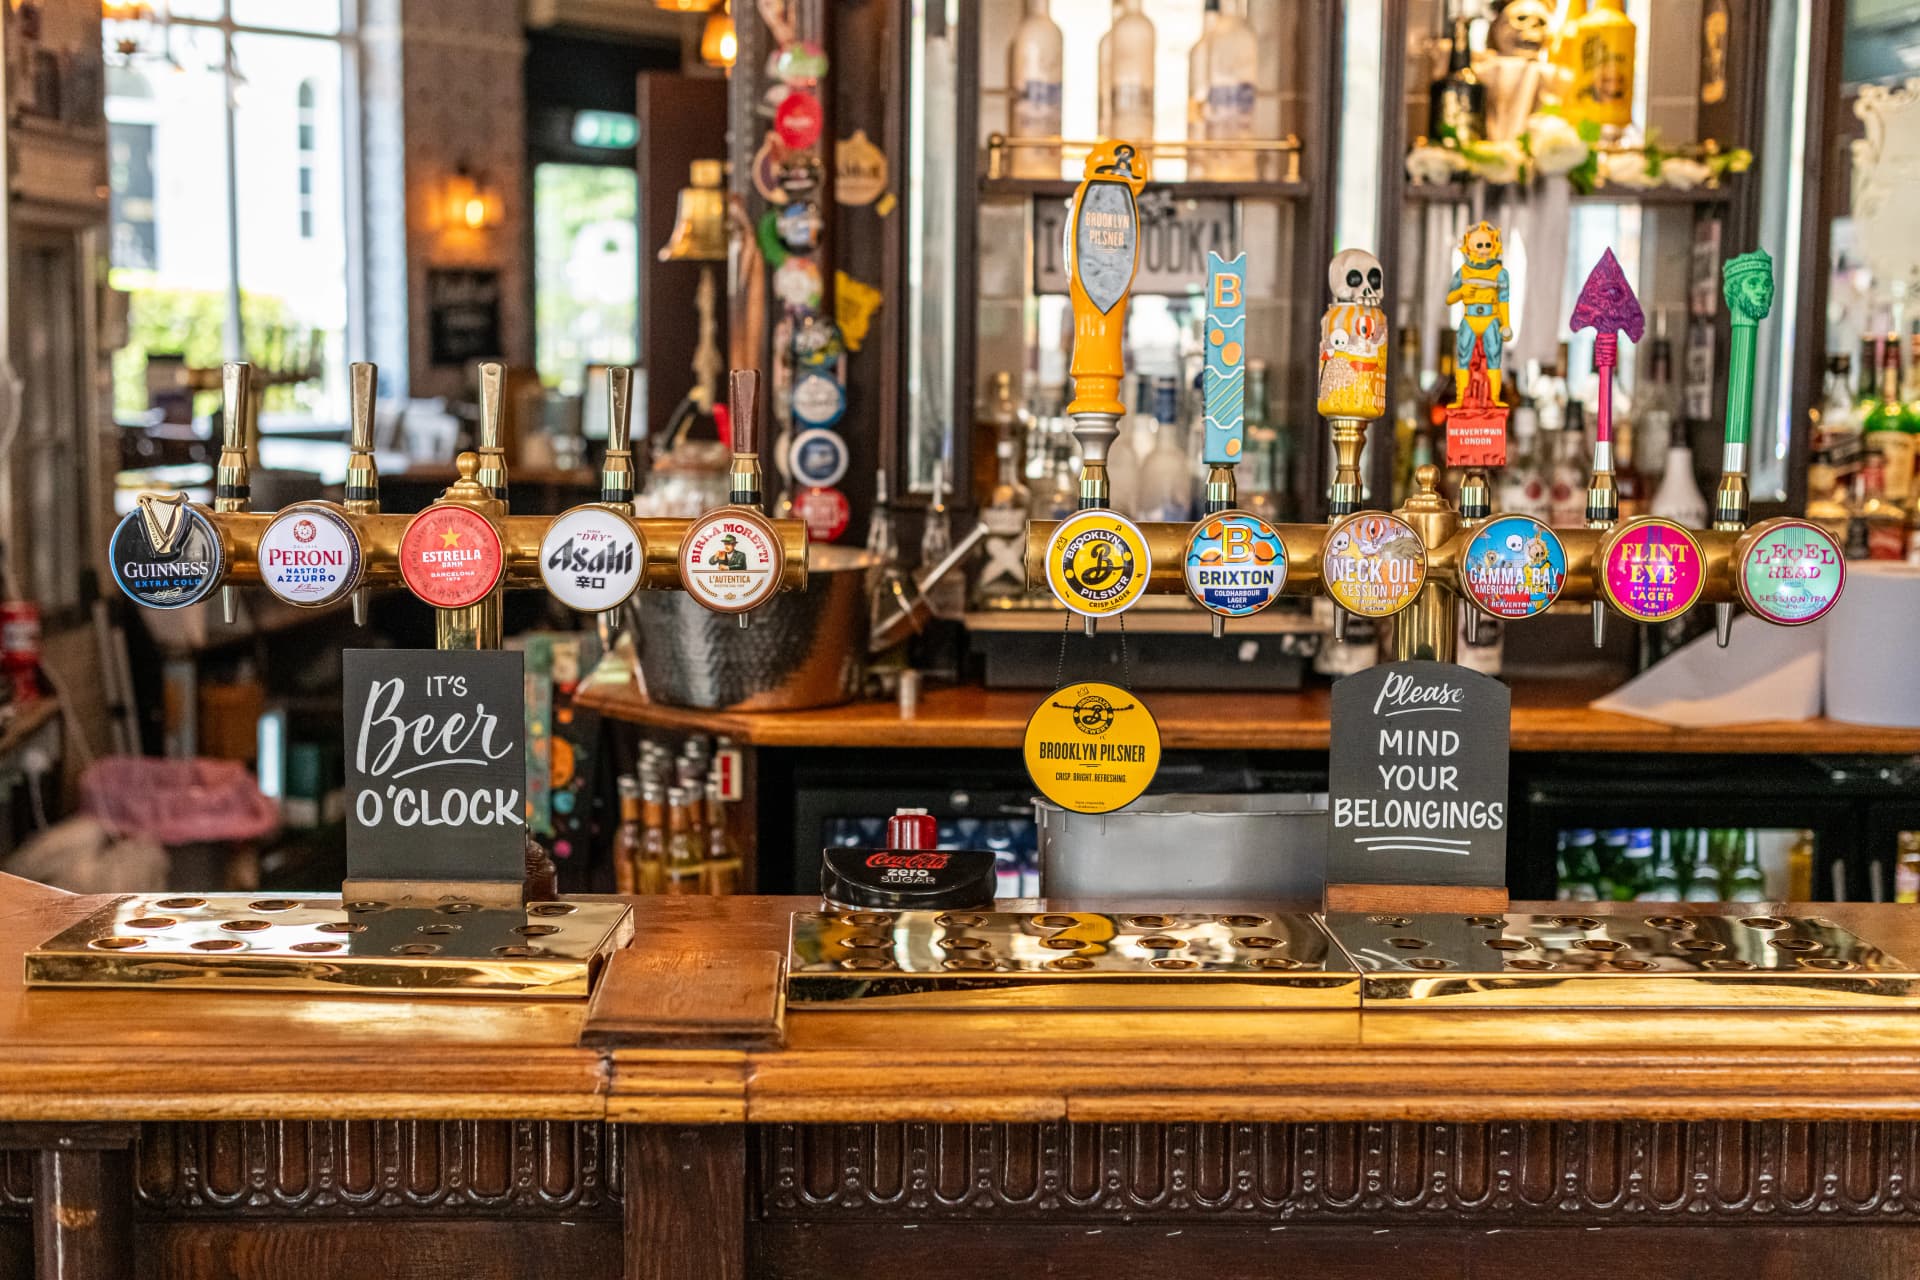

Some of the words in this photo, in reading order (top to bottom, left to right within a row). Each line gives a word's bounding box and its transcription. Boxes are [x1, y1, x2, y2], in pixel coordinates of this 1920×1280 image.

[1085, 211, 1130, 229] BROOKLYN
[1089, 230, 1124, 246] PILSNER
[1139, 219, 1227, 273] ODKA
[1213, 272, 1242, 308] B
[1449, 428, 1502, 436] BEAVERTOWN
[1459, 437, 1492, 445] LONDON
[723, 523, 769, 563] MORETTI
[1066, 531, 1121, 559] BROOKLYN
[1222, 523, 1256, 563] B
[269, 548, 343, 566] PERONI
[422, 549, 481, 563] ESTRELLA
[548, 536, 633, 575] Asahi
[1621, 543, 1689, 562] FLINT
[1755, 543, 1835, 565] LEVEL
[123, 561, 209, 578] GUINNESS
[277, 574, 336, 582] AZZURRO
[1199, 570, 1274, 585] BRIXTON
[1332, 558, 1383, 583] NECK
[1389, 559, 1418, 583] OIL
[1469, 567, 1525, 585] GAMMA
[1532, 567, 1560, 585] RAY
[1630, 564, 1678, 584] EYE
[1768, 566, 1821, 579] HEAD
[135, 579, 170, 588] EXTRA
[173, 578, 202, 586] COLD
[576, 575, 605, 589] 辛口
[708, 575, 751, 584] L'AUTENTICA
[1080, 575, 1129, 599] PILSNER
[1110, 589, 1132, 605] LAGER
[1214, 589, 1260, 597] COLDHARBOUR
[1342, 584, 1388, 597] SESSION
[1391, 584, 1409, 597] IPA
[1474, 584, 1516, 595] AMERICAN
[1518, 585, 1540, 595] PALE
[1542, 585, 1557, 594] ALE
[1630, 591, 1675, 601] LAGER
[1759, 594, 1806, 602] SESSION
[427, 675, 468, 697] IT'S
[1373, 671, 1465, 715] Please
[356, 677, 514, 776] Beer
[1379, 729, 1460, 756] MIND
[1039, 741, 1097, 761] BROOKLYN
[1100, 743, 1145, 763] PILSNER
[1378, 764, 1459, 791] YOUR
[356, 784, 525, 827] O'CLOCK
[1334, 798, 1503, 830] BELONGINGS
[880, 876, 936, 885] SUGAR
[887, 869, 930, 877] zero
